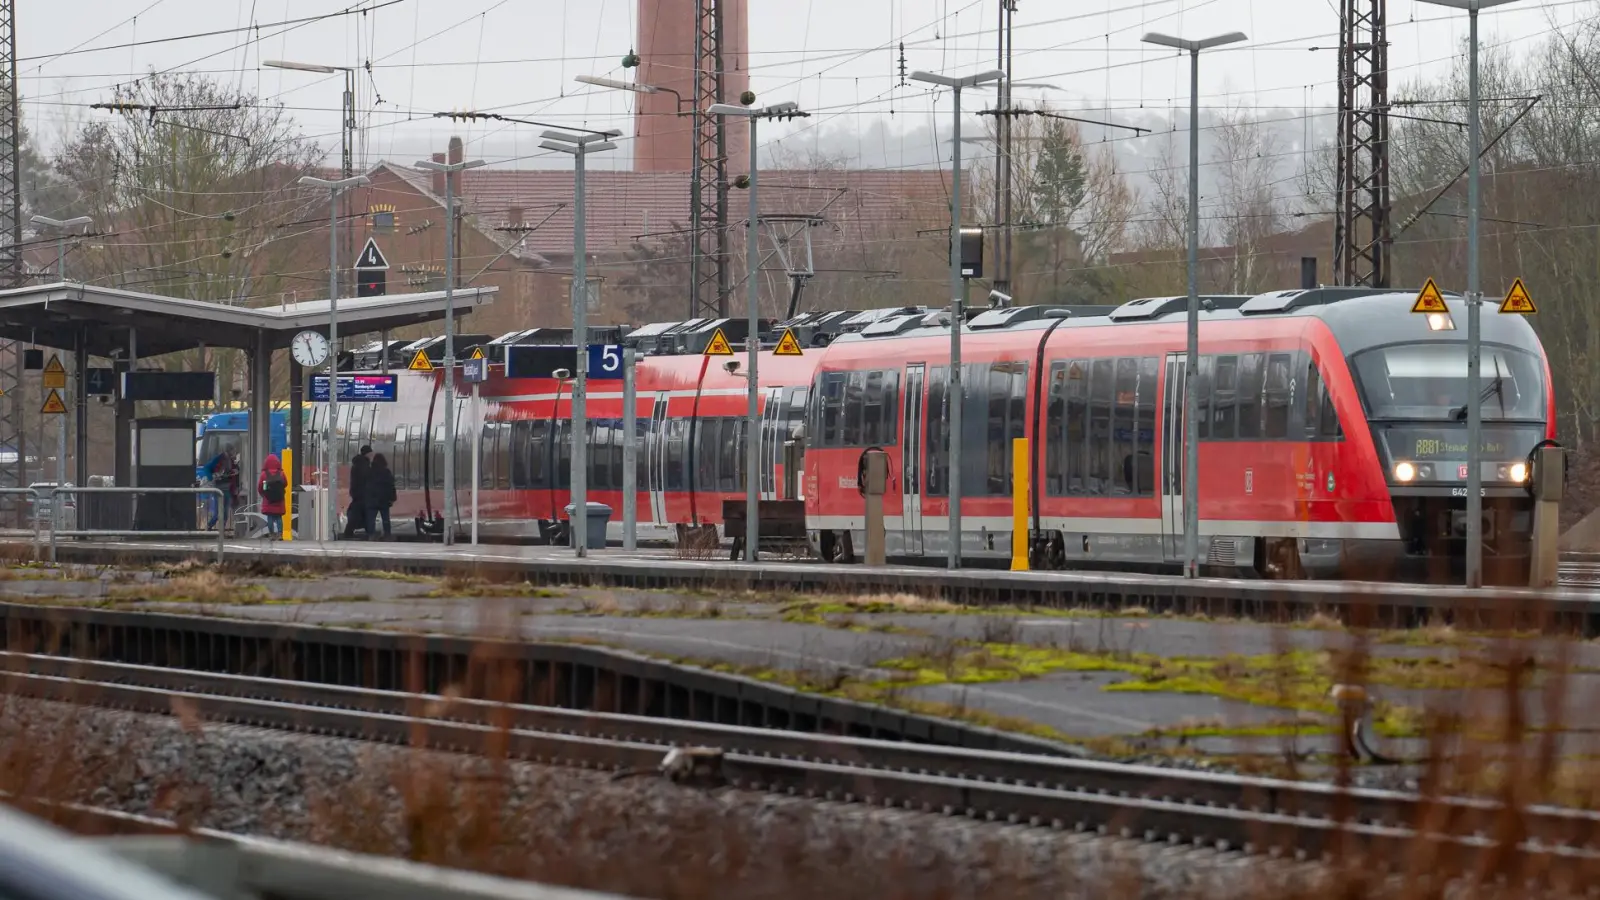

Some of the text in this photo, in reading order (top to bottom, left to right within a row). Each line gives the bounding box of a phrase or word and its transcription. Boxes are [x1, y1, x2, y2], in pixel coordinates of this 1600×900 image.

[369, 247, 377, 265] 4
[602, 344, 619, 371] 5
[90, 368, 104, 388] 4
